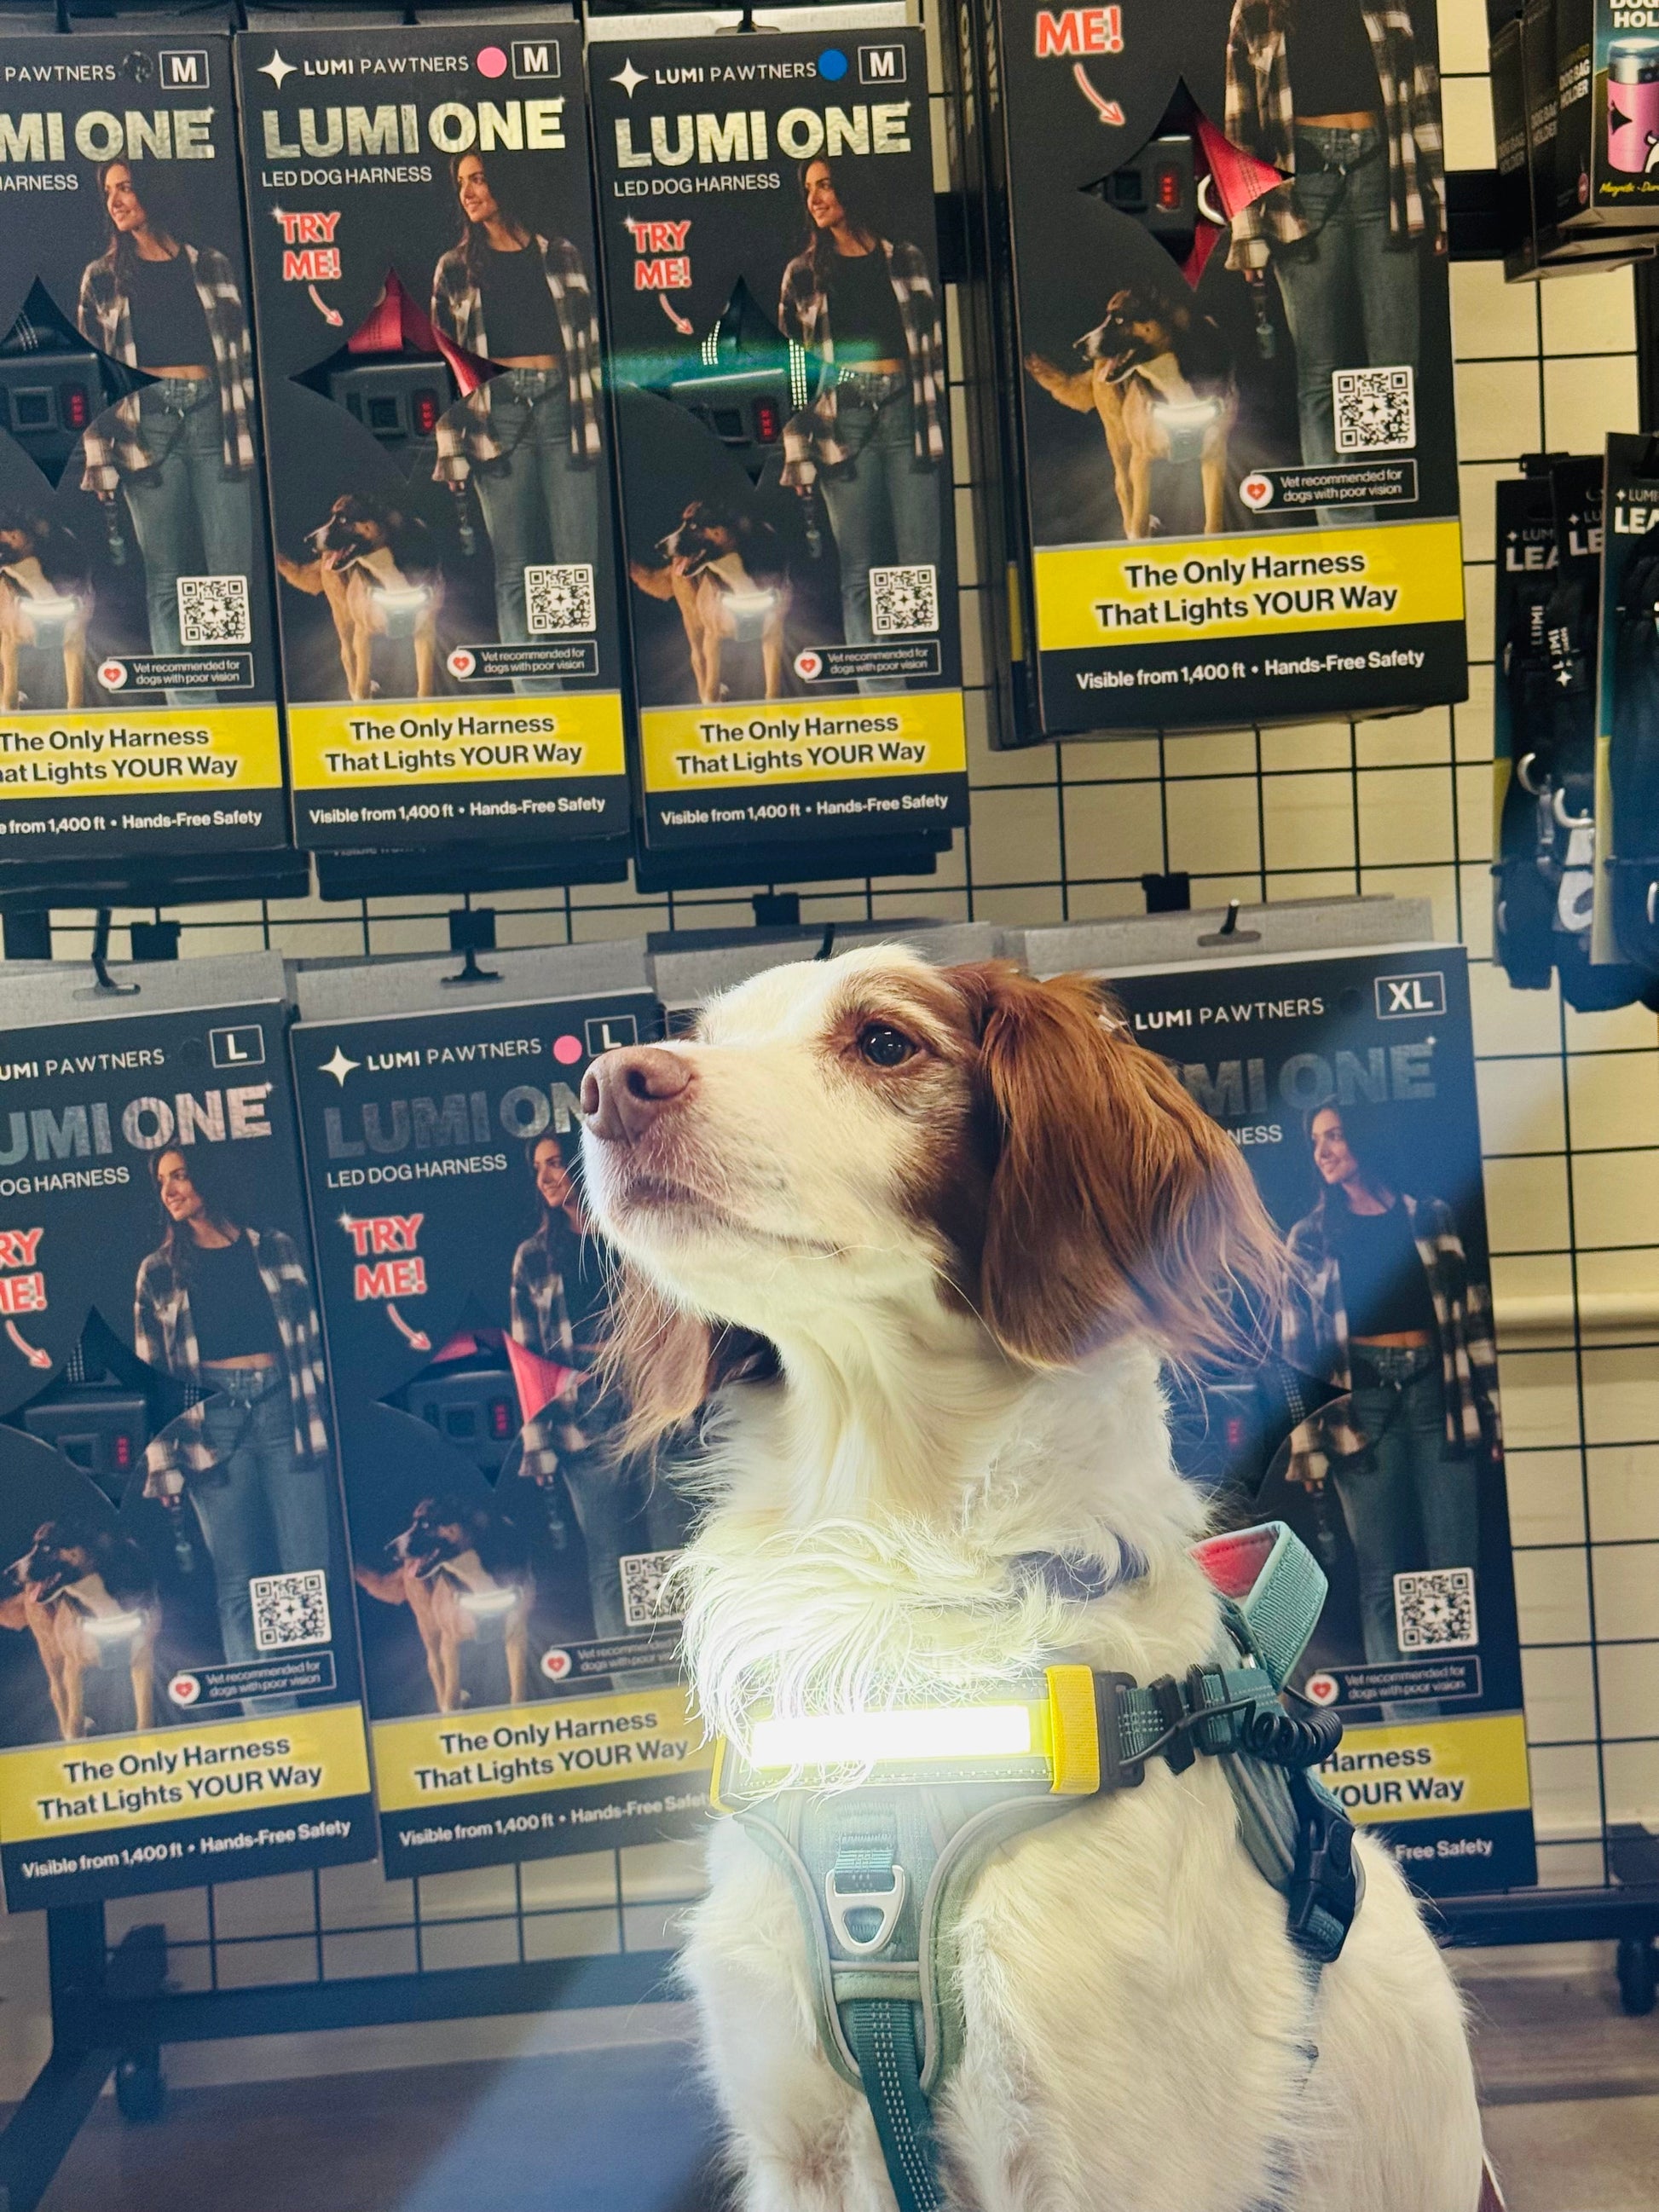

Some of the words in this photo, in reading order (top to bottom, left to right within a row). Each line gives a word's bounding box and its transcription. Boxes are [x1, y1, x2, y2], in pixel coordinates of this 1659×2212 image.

[1035, 5, 1124, 58] ME!
[1614, 11, 1659, 28] HOL
[5, 66, 116, 82] PAWTNERS
[171, 57, 197, 82] M
[303, 61, 354, 76] LUMI
[361, 56, 470, 74] PAWTNERS
[523, 47, 549, 72] M
[655, 67, 703, 85] LUMI
[711, 62, 817, 83] PAWTNERS
[870, 51, 894, 78] M
[0, 113, 65, 162] MI
[75, 109, 215, 162] ONE
[263, 104, 419, 159] LUMI
[429, 98, 566, 153] ONE
[615, 111, 768, 168] LUMI
[777, 102, 911, 159] ONE
[262, 170, 298, 188] LED
[301, 169, 342, 186] DOG
[345, 166, 432, 183] HARNESS
[614, 180, 650, 197] LED
[652, 177, 692, 195] DOG
[696, 174, 780, 192] HARNESS
[280, 211, 341, 244] TRY
[631, 220, 691, 253] TRY
[283, 249, 341, 280] ME!
[634, 256, 692, 290] ME!
[1280, 476, 1300, 488] Vet
[1301, 471, 1385, 487] recommended
[1387, 470, 1402, 480] for
[1283, 491, 1312, 503] dogs
[1314, 488, 1338, 500] with
[1340, 488, 1367, 500] poor
[1368, 484, 1402, 495] vision
[1615, 506, 1659, 534] LEA
[1125, 565, 1176, 589] The
[1183, 560, 1246, 586] Only
[1251, 553, 1365, 580] Harness
[1506, 546, 1558, 572] LEA
[1095, 604, 1158, 627] That
[1165, 597, 1248, 626] Lights
[1254, 590, 1334, 616] YOUR
[1340, 586, 1398, 612] Way
[133, 662, 151, 673] Vet
[151, 661, 225, 673] recommended
[226, 661, 240, 670] for
[136, 674, 163, 685] dogs
[163, 673, 185, 683] with
[186, 673, 210, 684] poor
[211, 672, 240, 682] vision
[1077, 671, 1134, 690] Visible
[1137, 668, 1177, 685] from
[1182, 665, 1228, 686] 1,400
[1233, 663, 1246, 679] ft
[1264, 657, 1365, 677] Hands-Free
[1368, 650, 1424, 670] Safety
[1, 732, 44, 751] The
[49, 730, 104, 752] Only
[109, 729, 209, 748] Harness
[350, 722, 395, 741] The
[401, 719, 453, 741] Only
[459, 717, 554, 736] Harness
[701, 724, 743, 742] The
[749, 720, 800, 742] Only
[806, 717, 898, 736] Harness
[0, 765, 27, 782] at
[33, 761, 107, 784] Lights
[113, 759, 183, 777] YOUR
[188, 756, 238, 777] Way
[326, 752, 379, 772] That
[384, 748, 455, 773] Lights
[460, 745, 528, 765] YOUR
[535, 743, 582, 765] Way
[677, 755, 727, 775] That
[734, 751, 802, 773] Lights
[807, 745, 873, 765] YOUR
[879, 742, 925, 763] Way
[10, 819, 45, 834] from
[48, 817, 91, 835] 1,400
[94, 816, 106, 829] ft
[123, 812, 211, 829] Hands-Free
[214, 810, 262, 826] Safety
[309, 808, 359, 824] Visible
[361, 806, 396, 821] from
[400, 805, 439, 822] 1,400
[441, 803, 453, 817] ft
[471, 800, 556, 817] Hands-Free
[558, 797, 605, 813] Safety
[661, 809, 708, 825] Visible
[711, 808, 744, 822] from
[748, 806, 787, 822] 1,400
[789, 804, 801, 817] ft
[817, 797, 899, 816] Hands-Free
[902, 794, 948, 810] Safety
[1388, 980, 1434, 1012] XL
[1135, 1008, 1192, 1031] LUMI
[1200, 997, 1324, 1024] PAWTNERS
[227, 1035, 247, 1060] L
[602, 1024, 621, 1049] L
[0, 1062, 38, 1081] UMI
[45, 1048, 165, 1076] PAWTNERS
[367, 1051, 419, 1071] LUMI
[427, 1038, 541, 1064] PAWTNERS
[1182, 1058, 1269, 1117] MI
[1280, 1042, 1436, 1108] ONE
[0, 1102, 113, 1165] UMI
[122, 1084, 272, 1149] ONE
[325, 1090, 491, 1159] LUMI
[500, 1082, 582, 1137] ON
[1228, 1124, 1283, 1146] NESS
[0, 1178, 30, 1196] OG
[34, 1167, 130, 1191] HARNESS
[327, 1170, 364, 1188] LED
[368, 1164, 413, 1184] DOG
[416, 1154, 507, 1178] HARNESS
[0, 1227, 43, 1268] RY
[348, 1212, 424, 1256] TRY
[354, 1256, 427, 1301] ME!
[440, 1734, 488, 1754] The
[494, 1724, 549, 1747] Only
[555, 1712, 657, 1740] Harness
[64, 1761, 113, 1783] The
[119, 1751, 177, 1775] Only
[184, 1738, 291, 1767] Harness
[414, 1765, 472, 1790] That
[477, 1757, 554, 1784] Lights
[559, 1745, 632, 1771] YOUR
[636, 1740, 688, 1760] Way
[1321, 1747, 1431, 1775] Harness
[38, 1795, 97, 1820] That
[104, 1787, 182, 1814] Lights
[188, 1772, 263, 1799] YOUR
[269, 1766, 322, 1788] Way
[1332, 1780, 1402, 1808] OUR
[1407, 1776, 1464, 1802] Way
[400, 1828, 453, 1847] Visible
[455, 1822, 493, 1839] from
[494, 1816, 540, 1836] 1,400
[542, 1814, 553, 1828] ft
[570, 1800, 662, 1824] Hands-Free
[665, 1793, 709, 1812] Safet
[22, 1857, 78, 1878] Visible
[80, 1853, 118, 1870] from
[122, 1845, 168, 1866] 1,400
[171, 1843, 182, 1857] ft
[200, 1828, 295, 1854] Hands-Free
[298, 1819, 351, 1839] Safety
[1436, 1839, 1492, 1858] Safety
